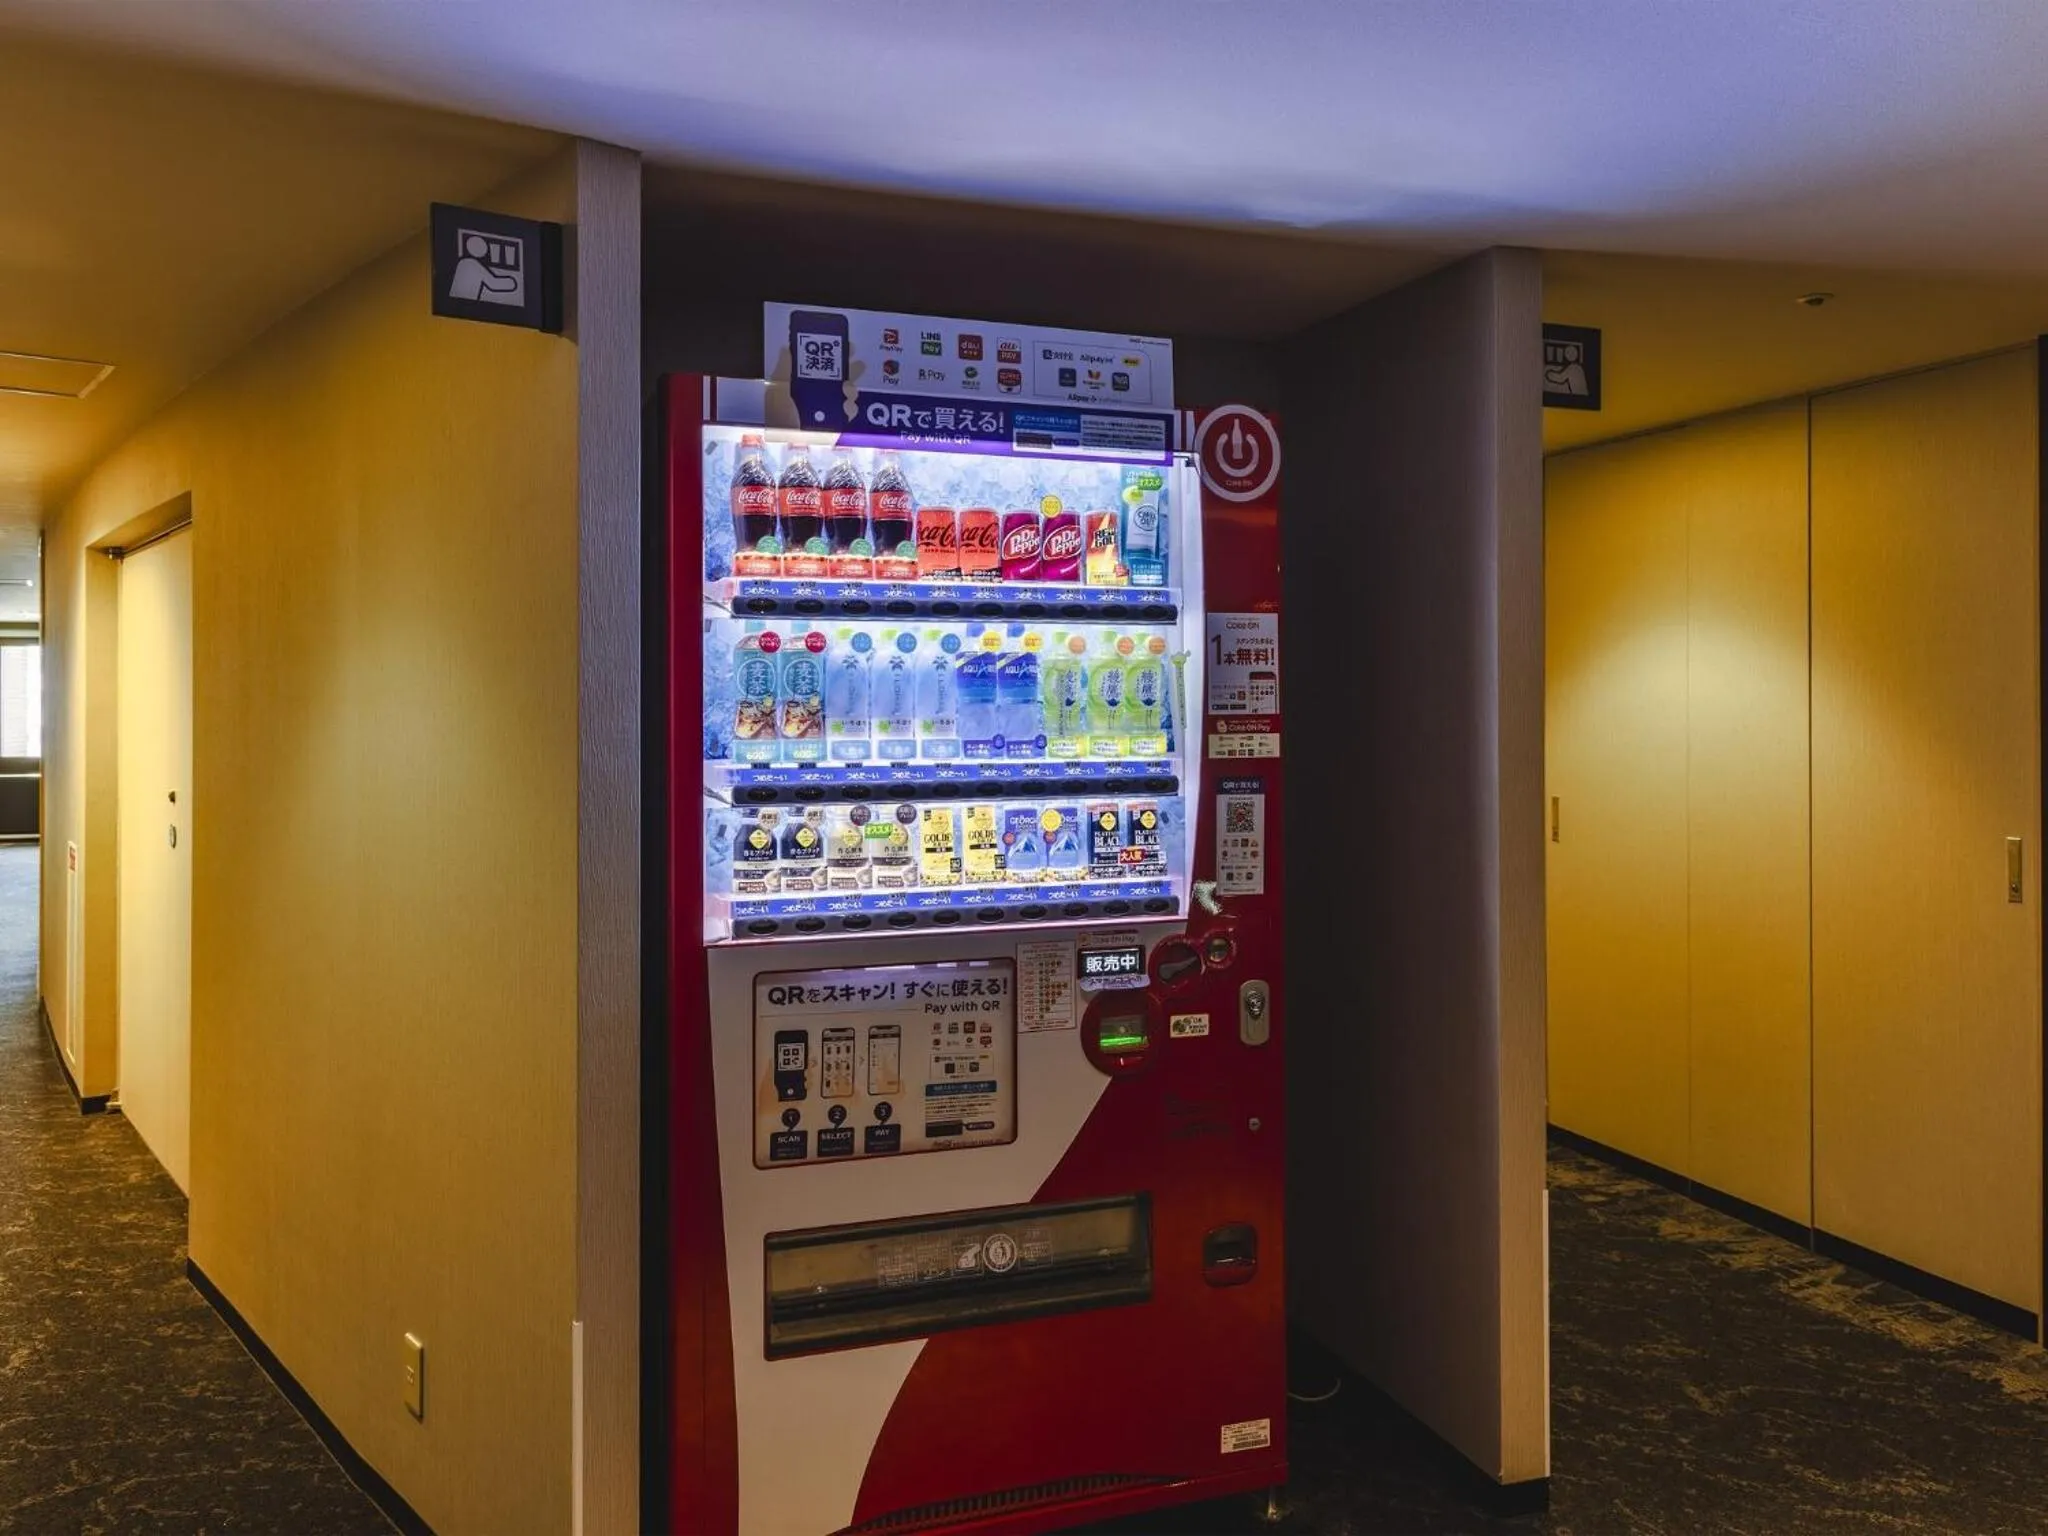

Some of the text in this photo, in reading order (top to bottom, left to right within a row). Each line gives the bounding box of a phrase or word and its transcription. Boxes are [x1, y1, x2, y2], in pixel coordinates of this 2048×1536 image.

[805, 355, 835, 372] 決済
[883, 375, 899, 386] Pay
[927, 370, 946, 382] Pay
[866, 402, 1004, 433] QRで買える!
[900, 430, 972, 444] Pay with QR
[1021, 530, 1036, 542] Dr
[1062, 531, 1077, 542] Dr
[1085, 953, 1136, 974] 販売中
[767, 977, 1008, 1006] QRをスキャン! すぐに使える!
[924, 1000, 1001, 1016] Pay with QR
